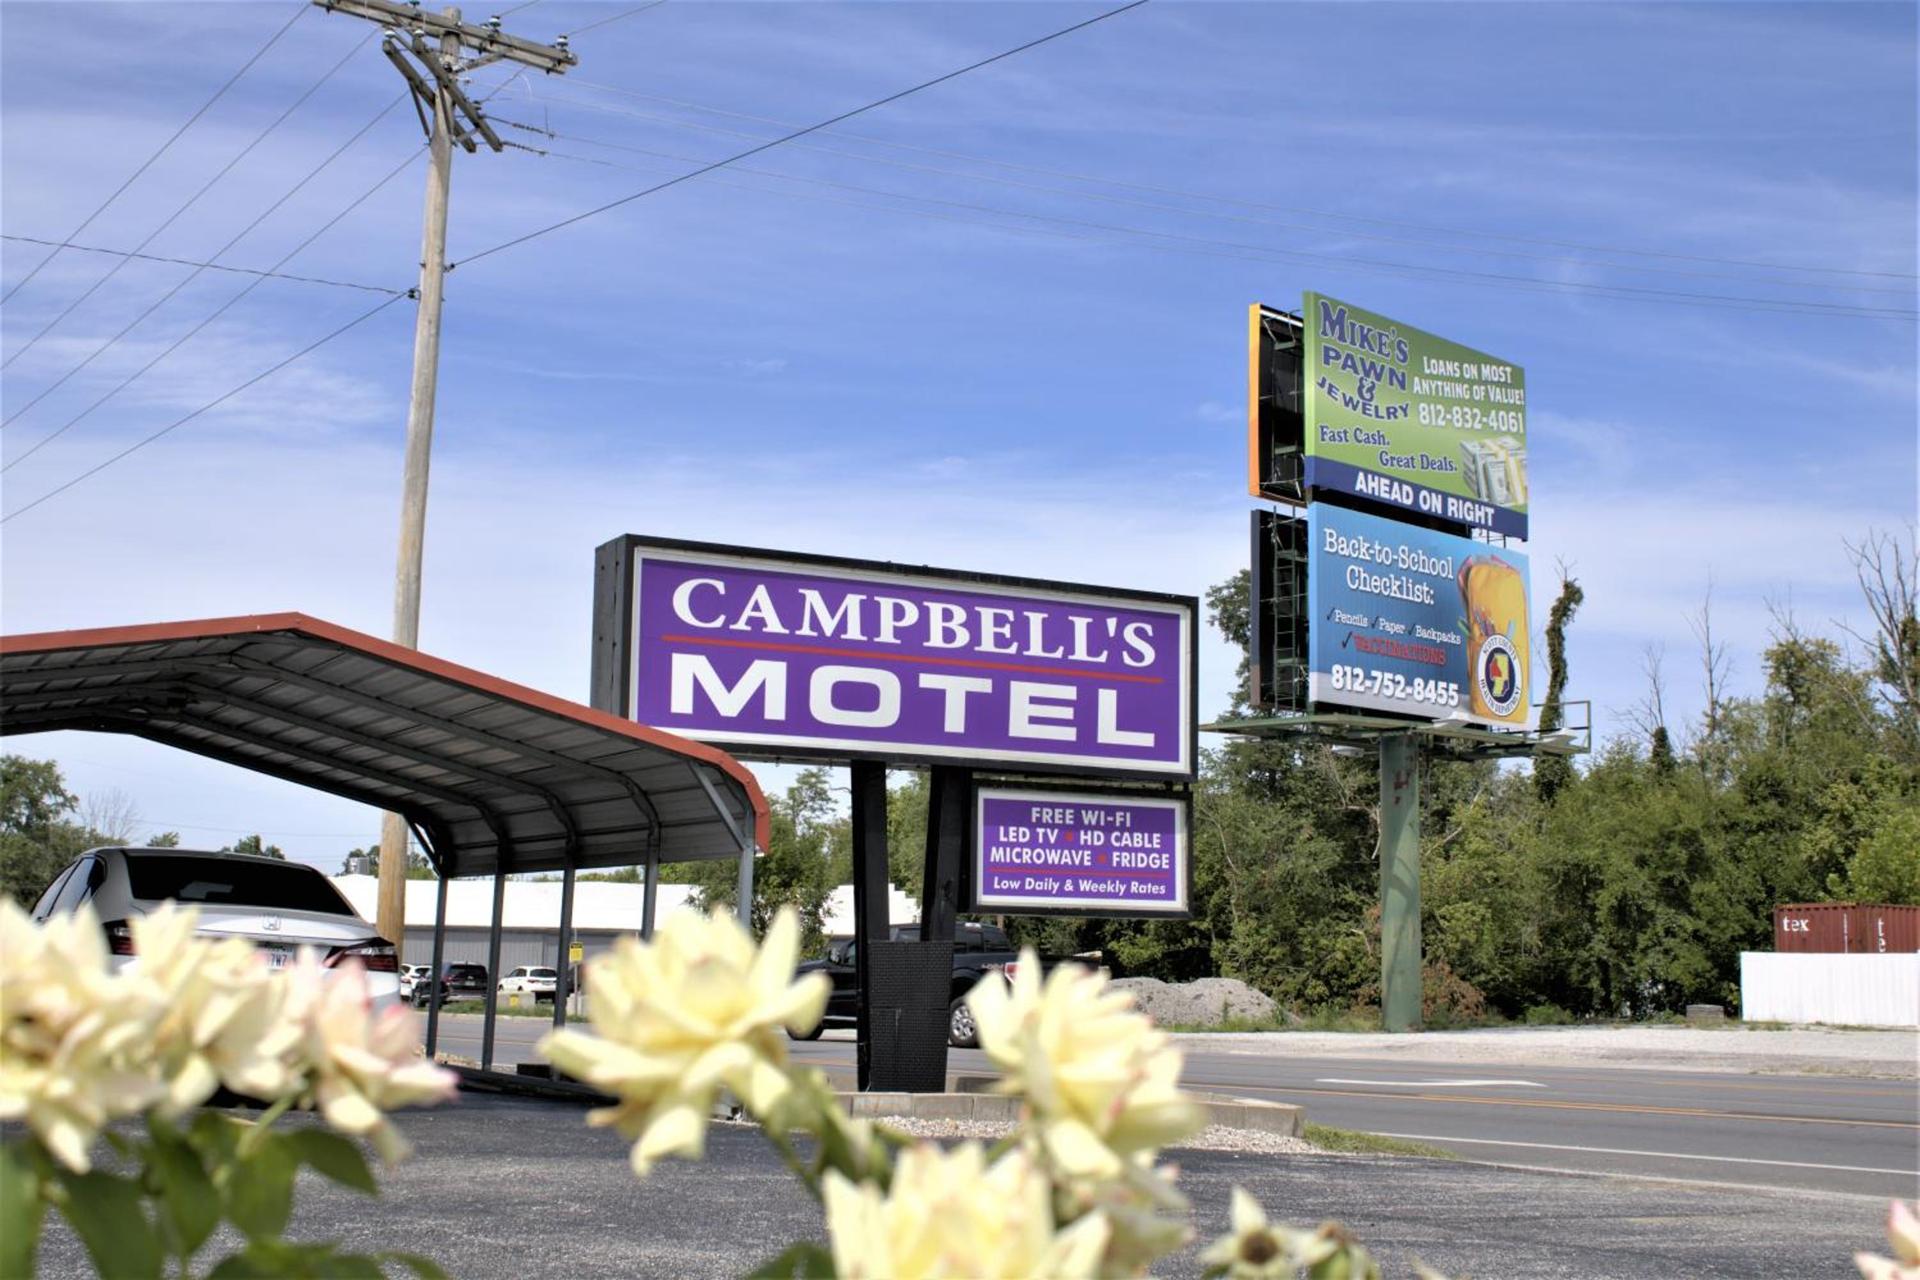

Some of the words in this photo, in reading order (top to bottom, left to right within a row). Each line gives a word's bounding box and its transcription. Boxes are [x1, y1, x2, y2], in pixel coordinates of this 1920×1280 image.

[1320, 300, 1408, 364] MIKE'S
[1322, 346, 1407, 391] PAWN
[1423, 357, 1460, 378] LOANS
[1463, 362, 1478, 379] ON
[1481, 364, 1512, 383] MOST
[1317, 377, 1409, 420] JEWELRY
[1357, 376, 1375, 401] &
[1413, 377, 1470, 399] ANYTHING
[1473, 386, 1486, 400] OF
[1488, 386, 1524, 404] VALUE!
[1419, 403, 1524, 433] 812-832-4061
[1319, 425, 1349, 443] Fast
[1353, 428, 1390, 445] Cash.
[1379, 451, 1415, 469] Great
[1420, 455, 1457, 472] Deals.
[1355, 472, 1414, 506] AHEAD
[1419, 490, 1442, 514] ON
[1448, 497, 1495, 526] RIGHT
[1323, 528, 1454, 579] Back-to-School
[1346, 565, 1435, 604] Checklist:
[672, 578, 1157, 668] CAMPBELL'S
[1334, 609, 1368, 627] Pencils
[1379, 618, 1406, 634] Paper
[1415, 626, 1462, 645] Backpacks
[670, 653, 1156, 748] MOTEL
[1331, 664, 1459, 707] 812-752-8455
[1031, 807, 1075, 825] FREE
[1081, 810, 1131, 827] WI-FI
[999, 826, 1030, 843] LED
[1036, 828, 1059, 844] TV
[1080, 831, 1104, 846] HD
[1110, 832, 1161, 848] CABLE
[990, 847, 1091, 866] MICROWAVE
[1112, 852, 1170, 868] FRIDGE
[994, 876, 1021, 890] Low
[1025, 877, 1060, 895] Daily
[1064, 880, 1074, 892] &
[1079, 880, 1127, 896] Weekly
[1131, 881, 1166, 895] Rates
[1783, 916, 1809, 932] tex
